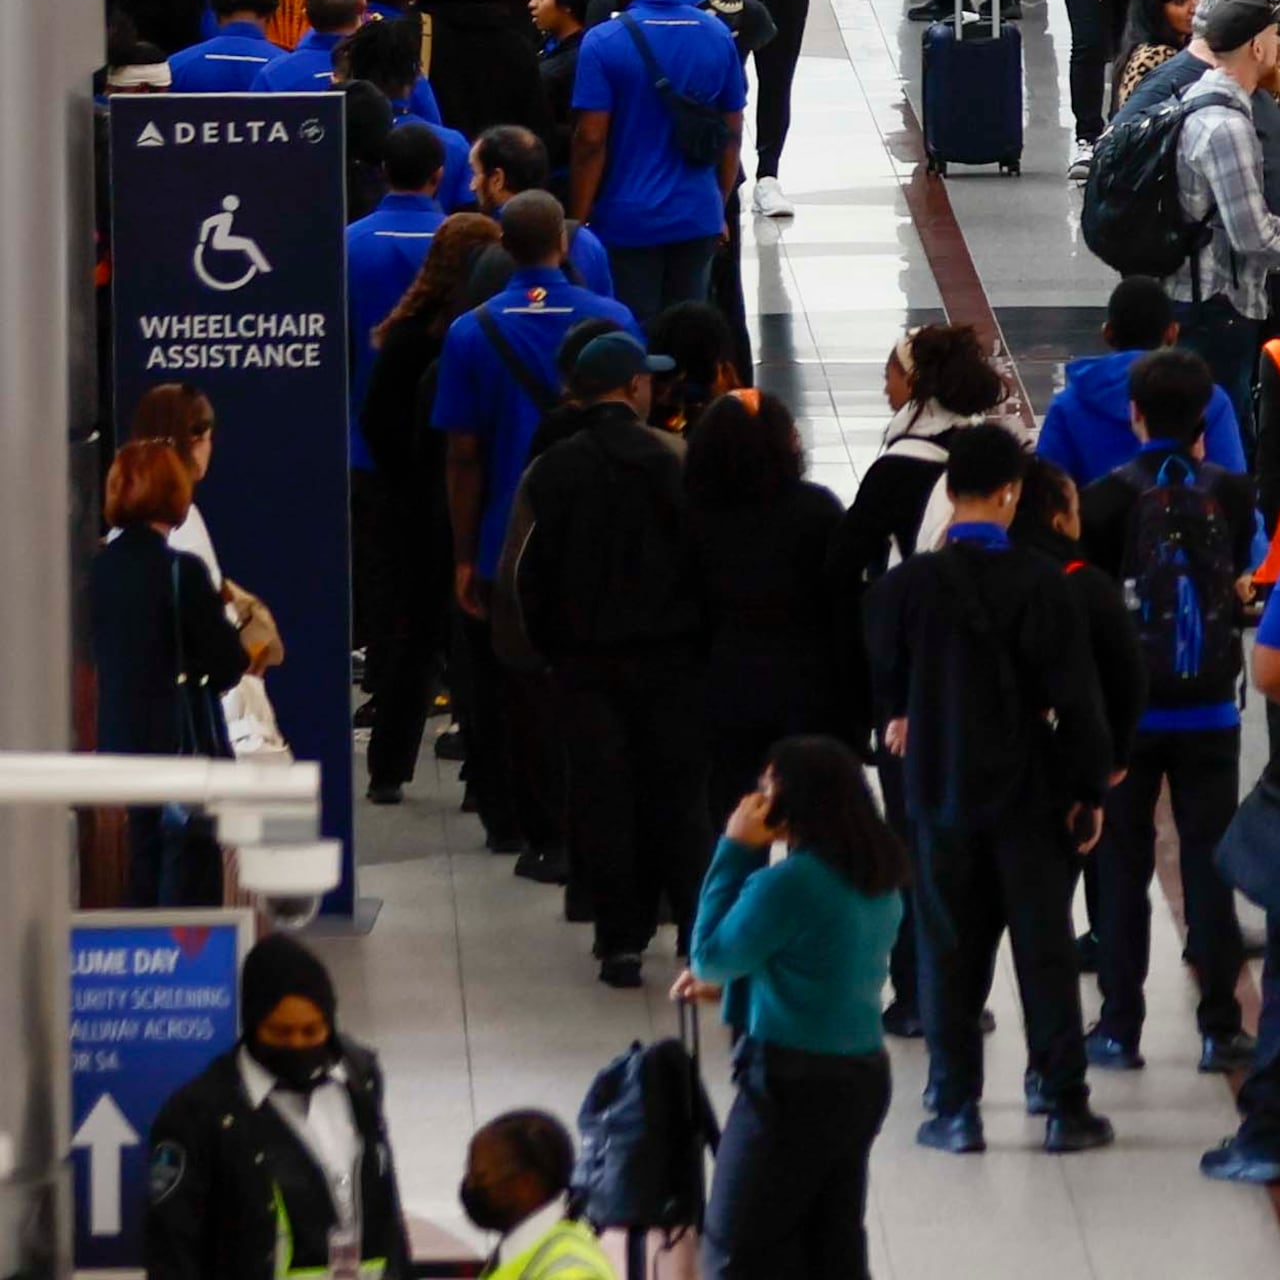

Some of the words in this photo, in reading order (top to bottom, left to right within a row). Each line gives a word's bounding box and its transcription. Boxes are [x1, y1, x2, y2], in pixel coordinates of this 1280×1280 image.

[174, 121, 290, 145] DELTA
[139, 313, 327, 339] WHEELCHAIR
[146, 342, 322, 370] ASSISTANCE
[134, 946, 181, 975] DAY
[132, 985, 231, 1010] SCREENING
[143, 1016, 215, 1041] ACROSS
